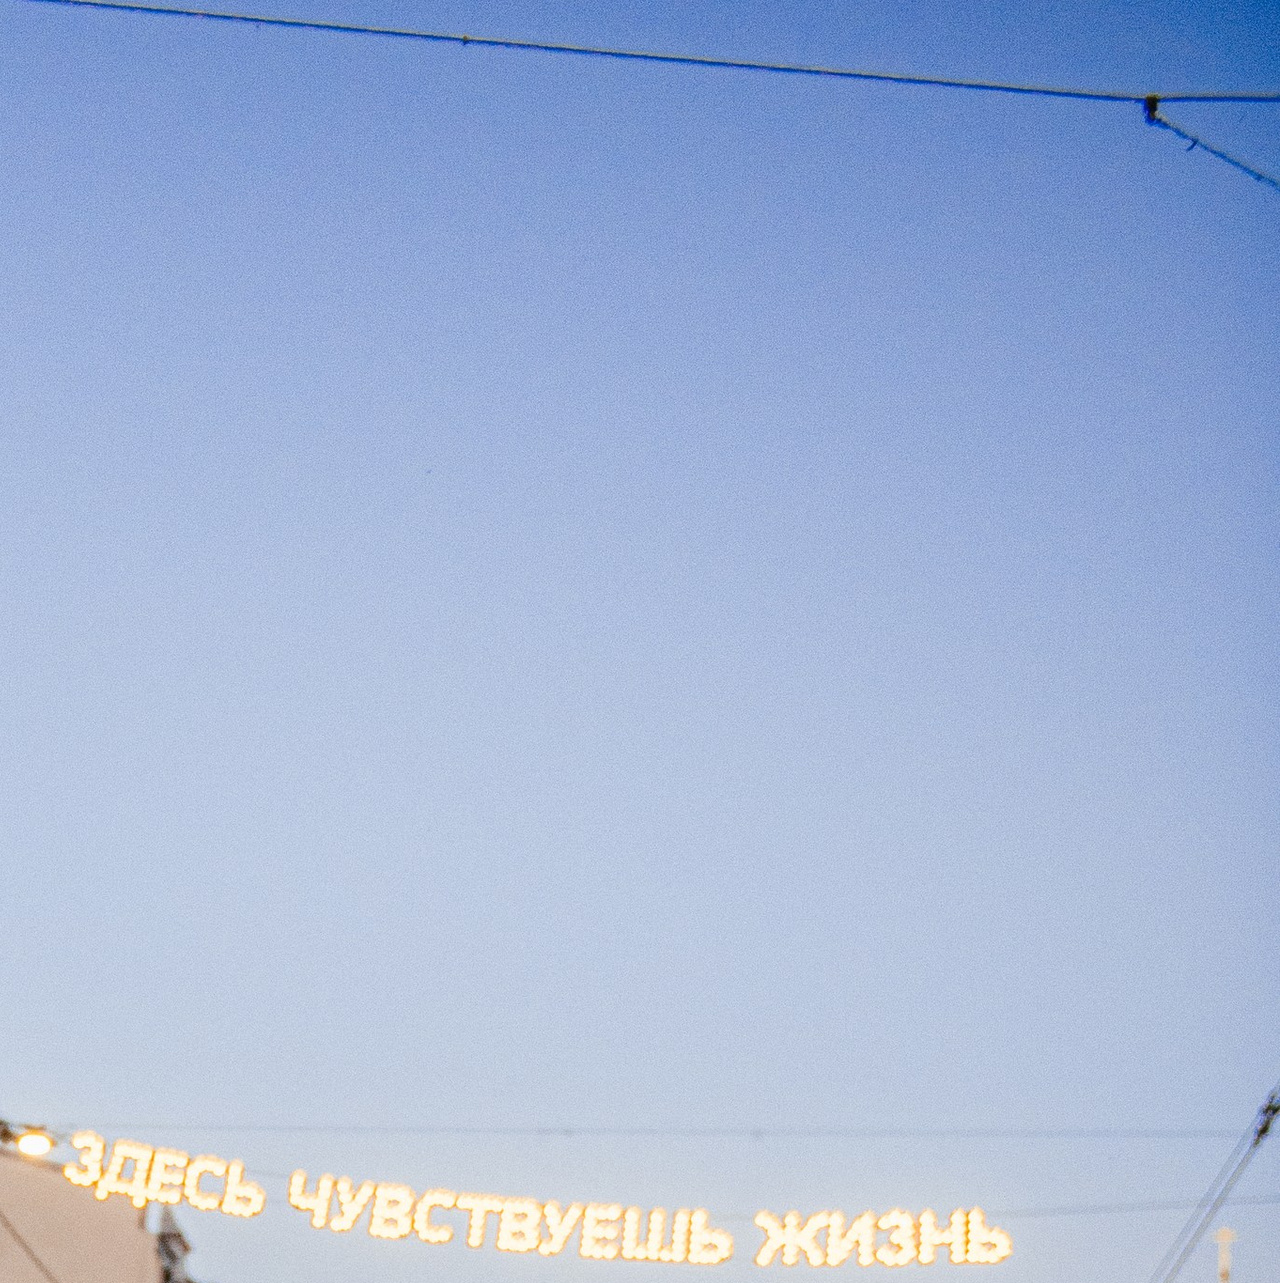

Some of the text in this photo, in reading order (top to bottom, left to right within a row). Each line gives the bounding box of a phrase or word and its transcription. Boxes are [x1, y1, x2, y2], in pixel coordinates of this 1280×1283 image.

[63, 1130, 1013, 1267] ЗДЕСЬ ЧУВСТВУЕШЬ ЖИЗНЬ
